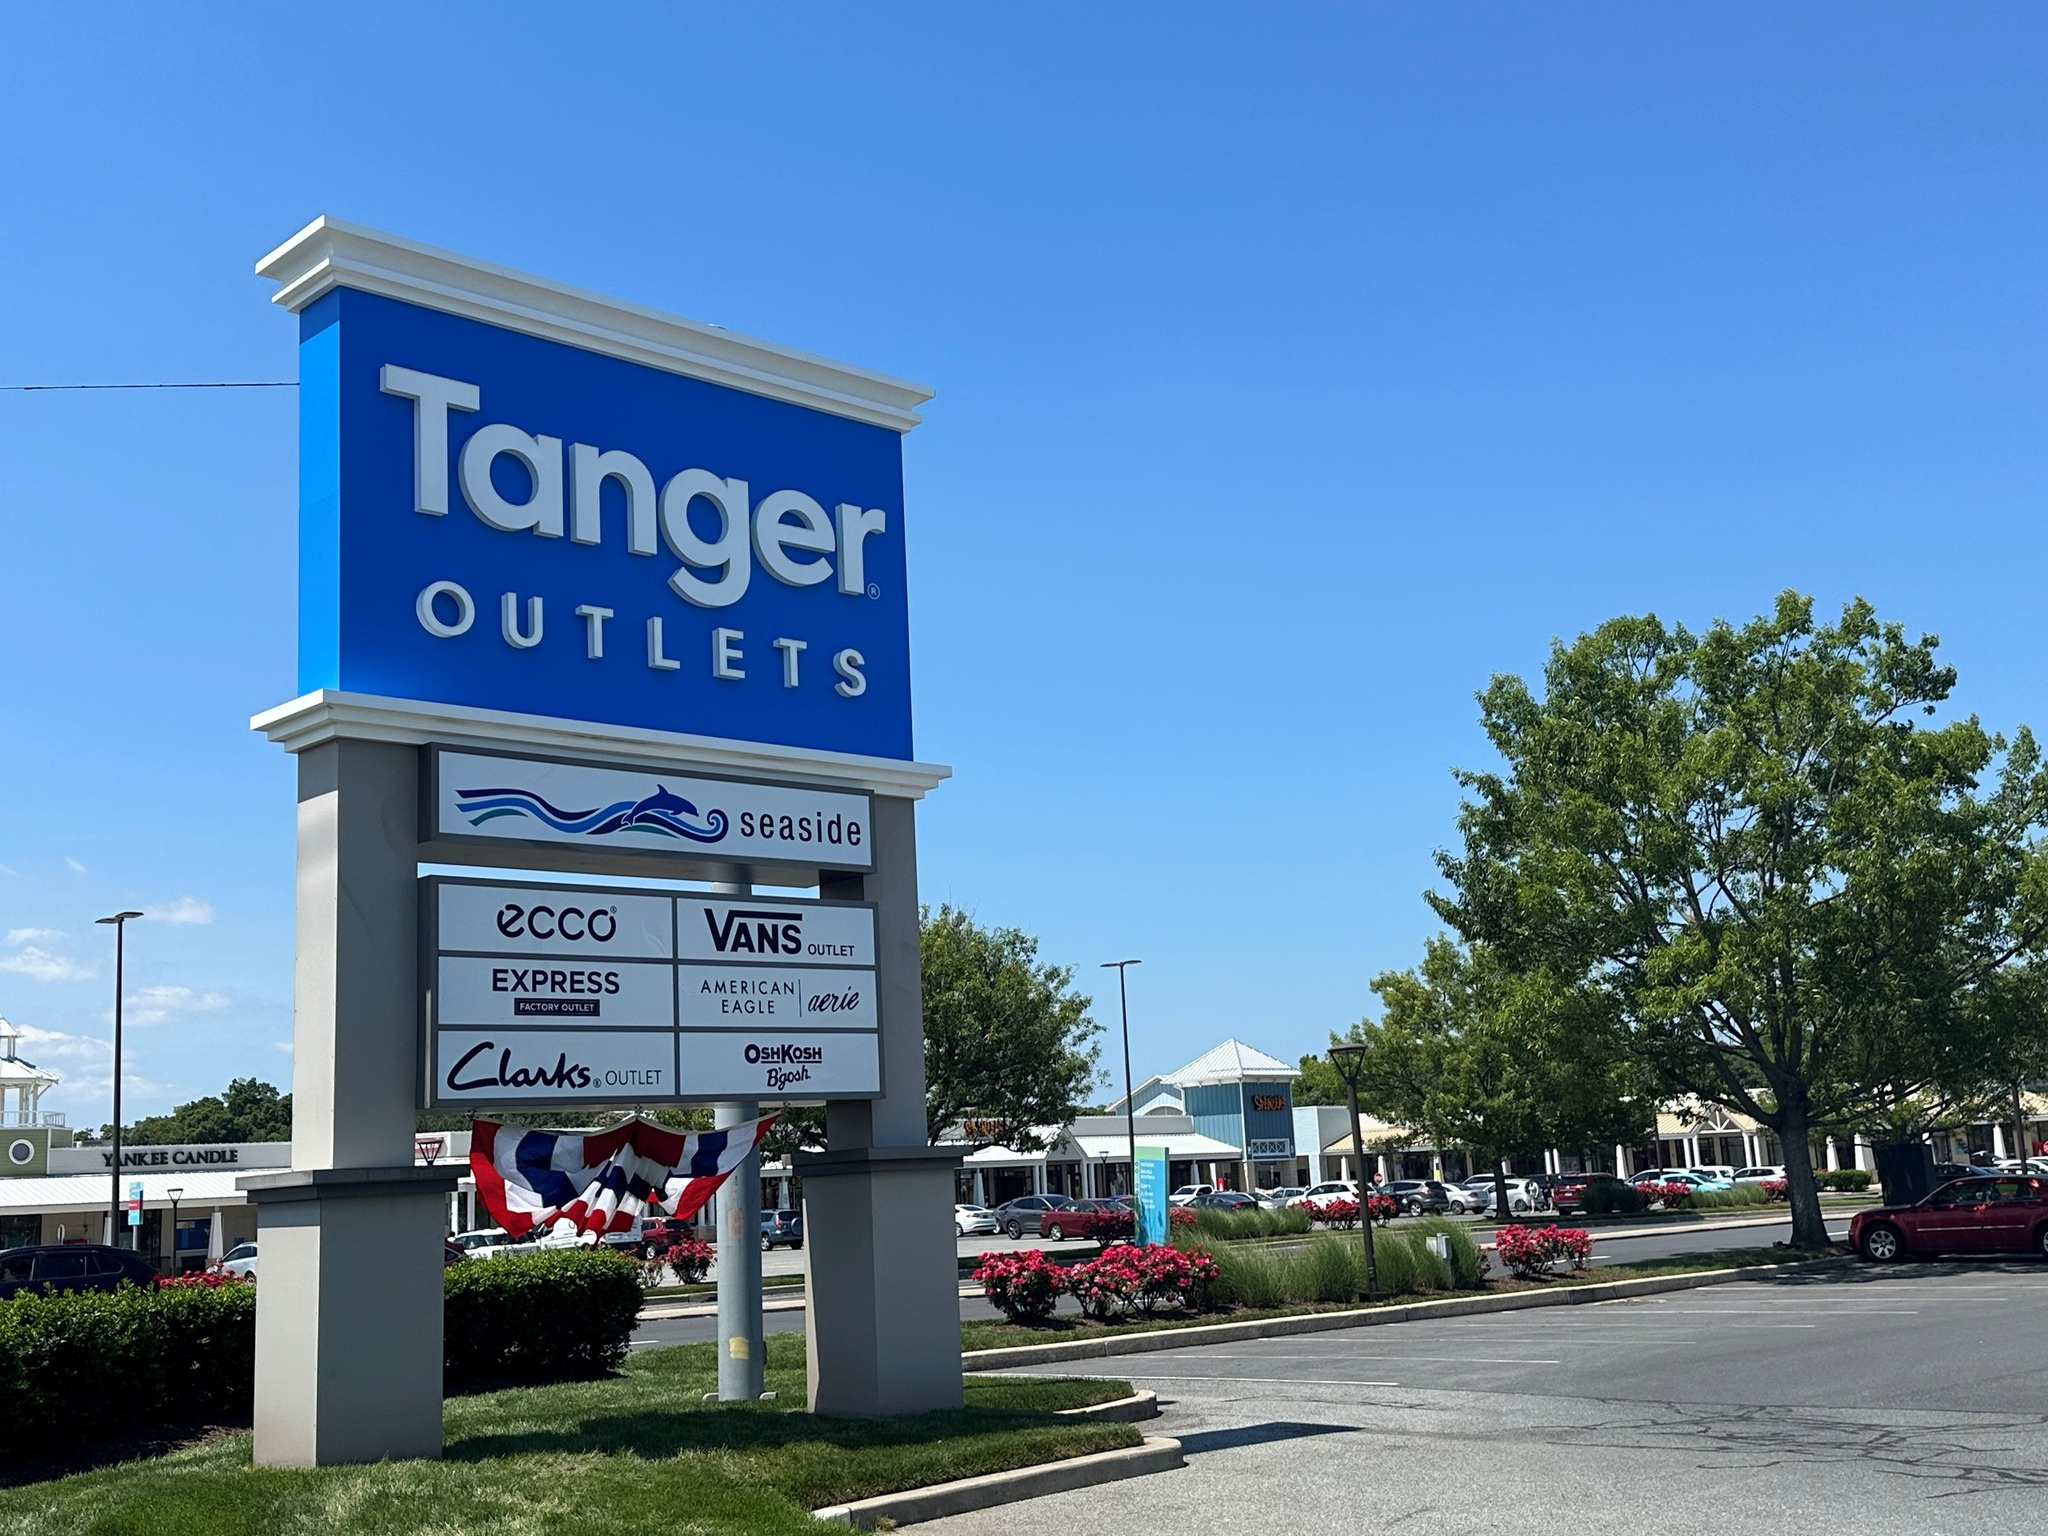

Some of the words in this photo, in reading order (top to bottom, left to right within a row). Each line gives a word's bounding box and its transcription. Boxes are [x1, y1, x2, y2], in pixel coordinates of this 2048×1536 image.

[379, 363, 886, 608] Tanger
[415, 580, 868, 699] OUTLETS
[740, 811, 861, 846] seaside
[496, 904, 617, 942] ecco
[703, 908, 803, 955] VANS
[807, 943, 855, 957] OUTLET
[492, 968, 620, 995] EXPRESS
[700, 979, 795, 995] AMERICAN
[519, 1002, 560, 1011] FACTORY
[561, 1003, 595, 1012] OUTLET
[721, 999, 775, 1014] EAGLE
[807, 986, 860, 1012] aerie
[446, 1041, 592, 1091] Clarks
[604, 1069, 662, 1086] OUTLET
[172, 1149, 239, 1165] CANDLE
